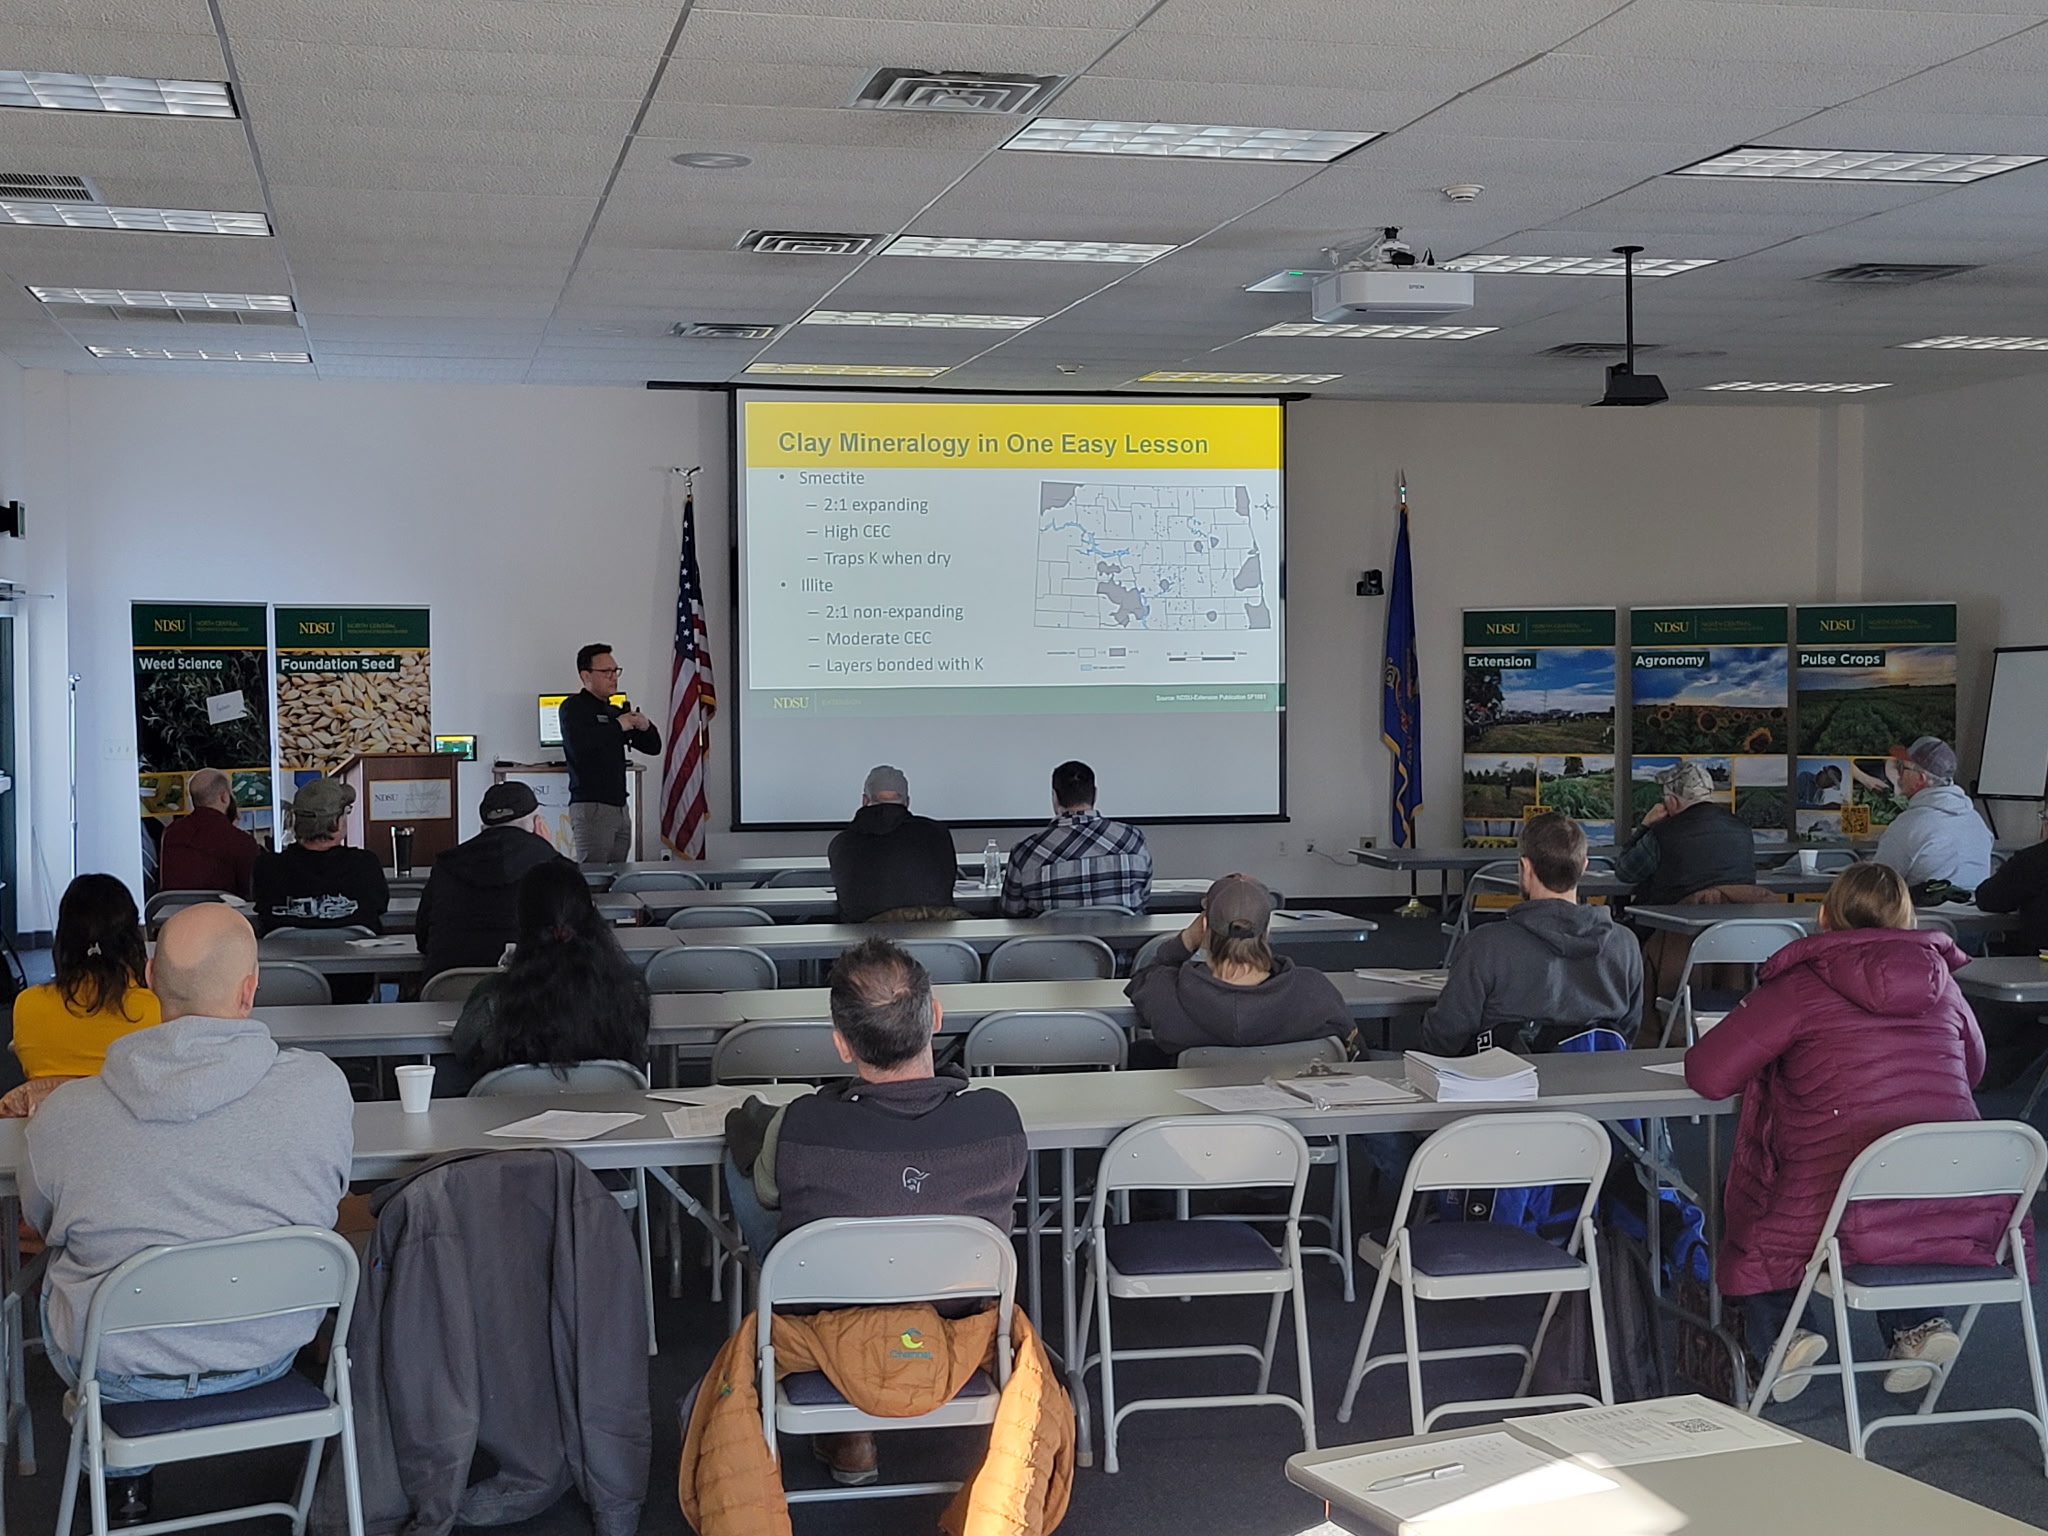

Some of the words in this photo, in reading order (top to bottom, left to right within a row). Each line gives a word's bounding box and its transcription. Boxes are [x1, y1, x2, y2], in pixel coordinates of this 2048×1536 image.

[779, 432, 831, 457] Clay
[840, 432, 970, 458] Mineralogy
[978, 433, 998, 453] in
[1006, 433, 1053, 454] One
[1062, 434, 1118, 458] Easy
[1126, 434, 1208, 454] Lesson
[799, 471, 865, 485] Smectite
[824, 498, 848, 512] 2:1
[852, 497, 929, 515] expanding
[824, 524, 859, 541] High
[863, 524, 891, 538] CEC
[824, 551, 865, 568] Traps
[869, 551, 879, 564] K
[882, 550, 923, 565] when
[927, 550, 951, 568] dry
[801, 578, 833, 592] Illite
[826, 605, 849, 619] 2:1
[853, 604, 964, 621] non-expanding
[154, 619, 186, 632] NDSU
[299, 622, 335, 634] NDSU
[1486, 623, 1520, 634] NDSU
[1654, 622, 1689, 633] NDSU
[1820, 619, 1856, 631] NDSU
[826, 632, 899, 645] Moderate
[904, 632, 932, 644] CEC
[139, 658, 175, 670] Weed
[178, 657, 223, 669] Science
[281, 658, 358, 670] Foundation
[361, 658, 395, 669] Seed
[826, 659, 872, 674] Layers
[877, 658, 933, 671] bonded
[937, 658, 970, 671] with
[975, 658, 984, 670] K
[1468, 656, 1531, 667] Extension
[1635, 655, 1705, 667] Agronomy
[1801, 654, 1836, 665] Pulse
[1840, 654, 1880, 666] Crops
[773, 697, 809, 709] NDSU
